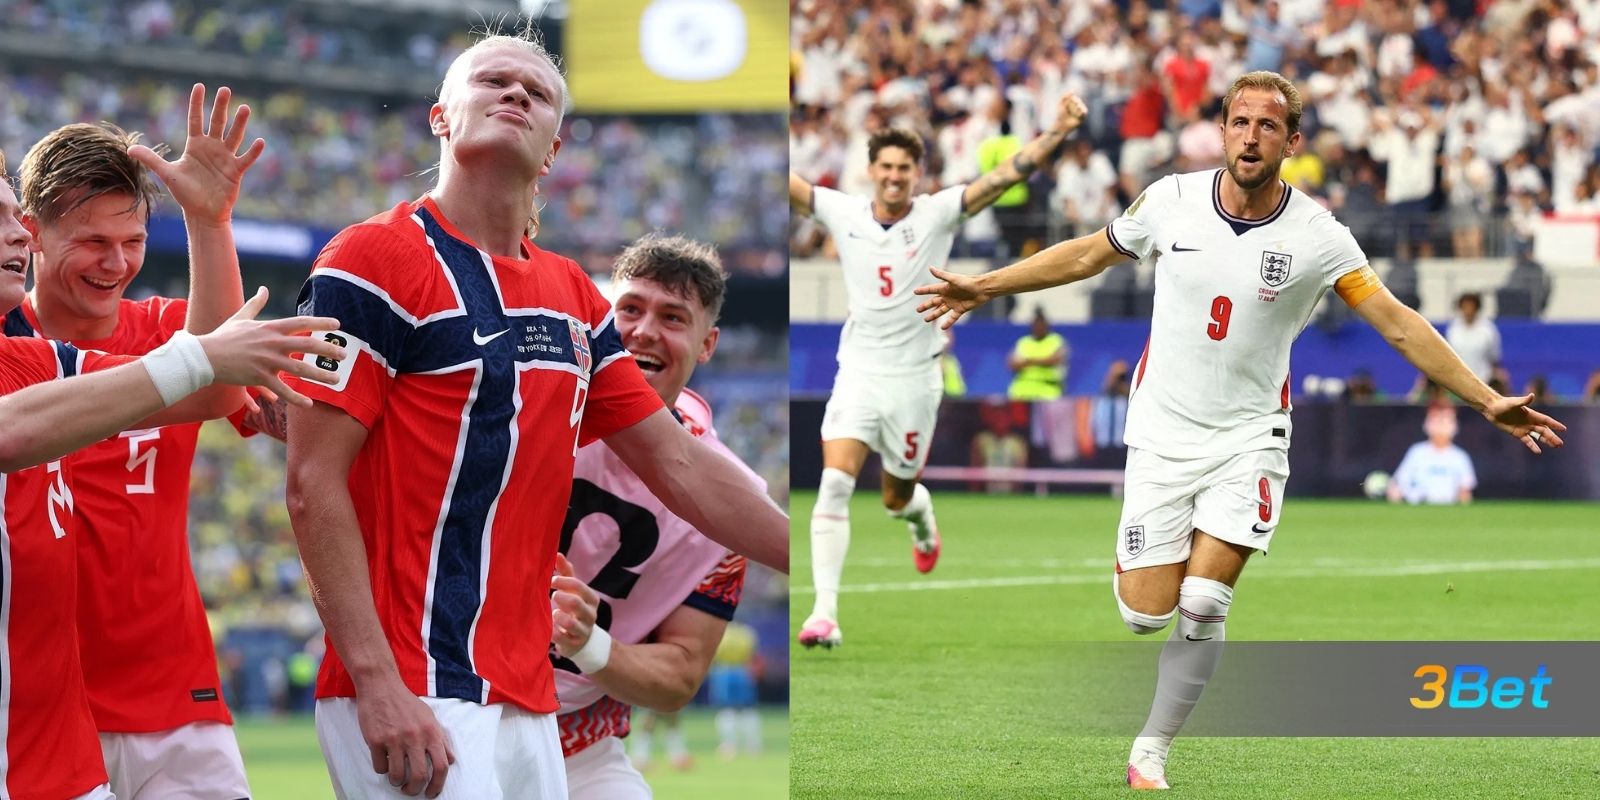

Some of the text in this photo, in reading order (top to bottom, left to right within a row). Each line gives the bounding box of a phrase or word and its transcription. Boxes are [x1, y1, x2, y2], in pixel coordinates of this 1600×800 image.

[878, 266, 894, 297] 5
[1206, 295, 1233, 341] 9
[119, 428, 161, 495] 5
[904, 432, 919, 460] 5
[1258, 476, 1272, 523] 9
